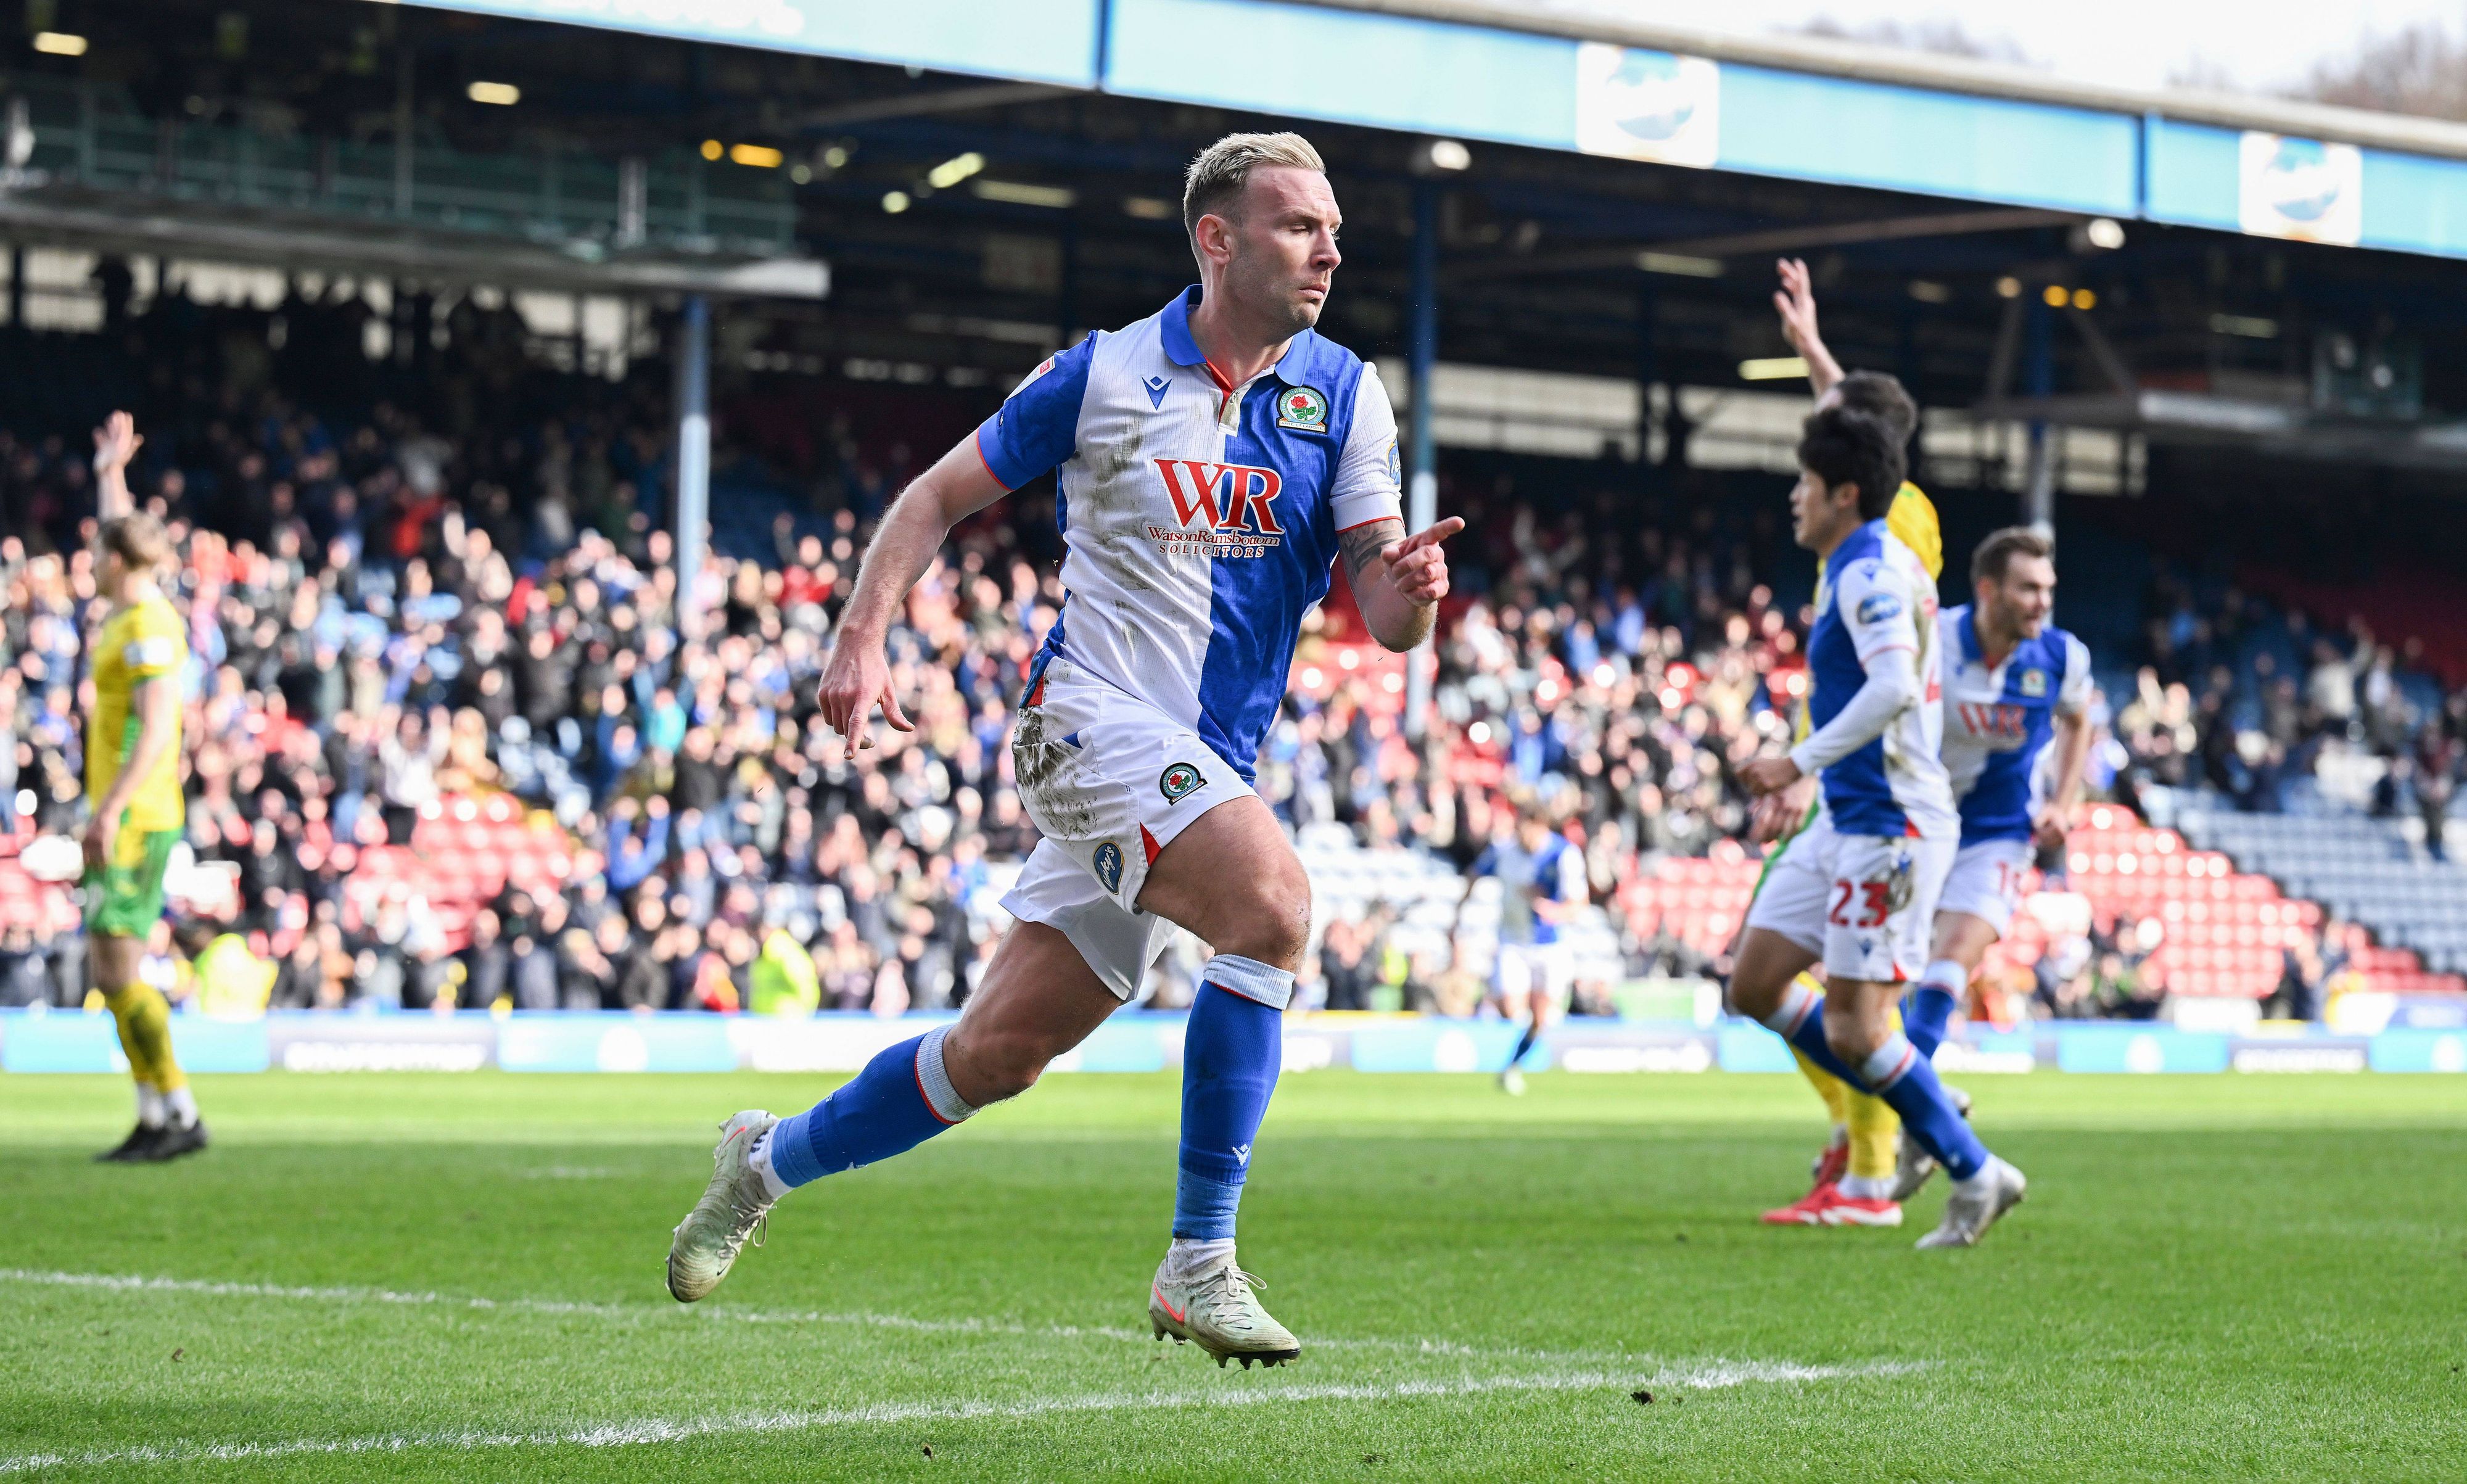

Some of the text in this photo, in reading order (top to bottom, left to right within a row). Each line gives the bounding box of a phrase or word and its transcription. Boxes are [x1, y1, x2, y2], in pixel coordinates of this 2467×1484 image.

[1281, 388, 1303, 414] BLACKBURN
[1304, 389, 1325, 408] ROVERS
[1153, 458, 1285, 533] WR
[1147, 526, 1279, 545] WatsonRamsbottom
[1159, 544, 1264, 557] SOLICITORS
[1957, 701, 2027, 736] WR
[1828, 878, 1888, 928] 23
